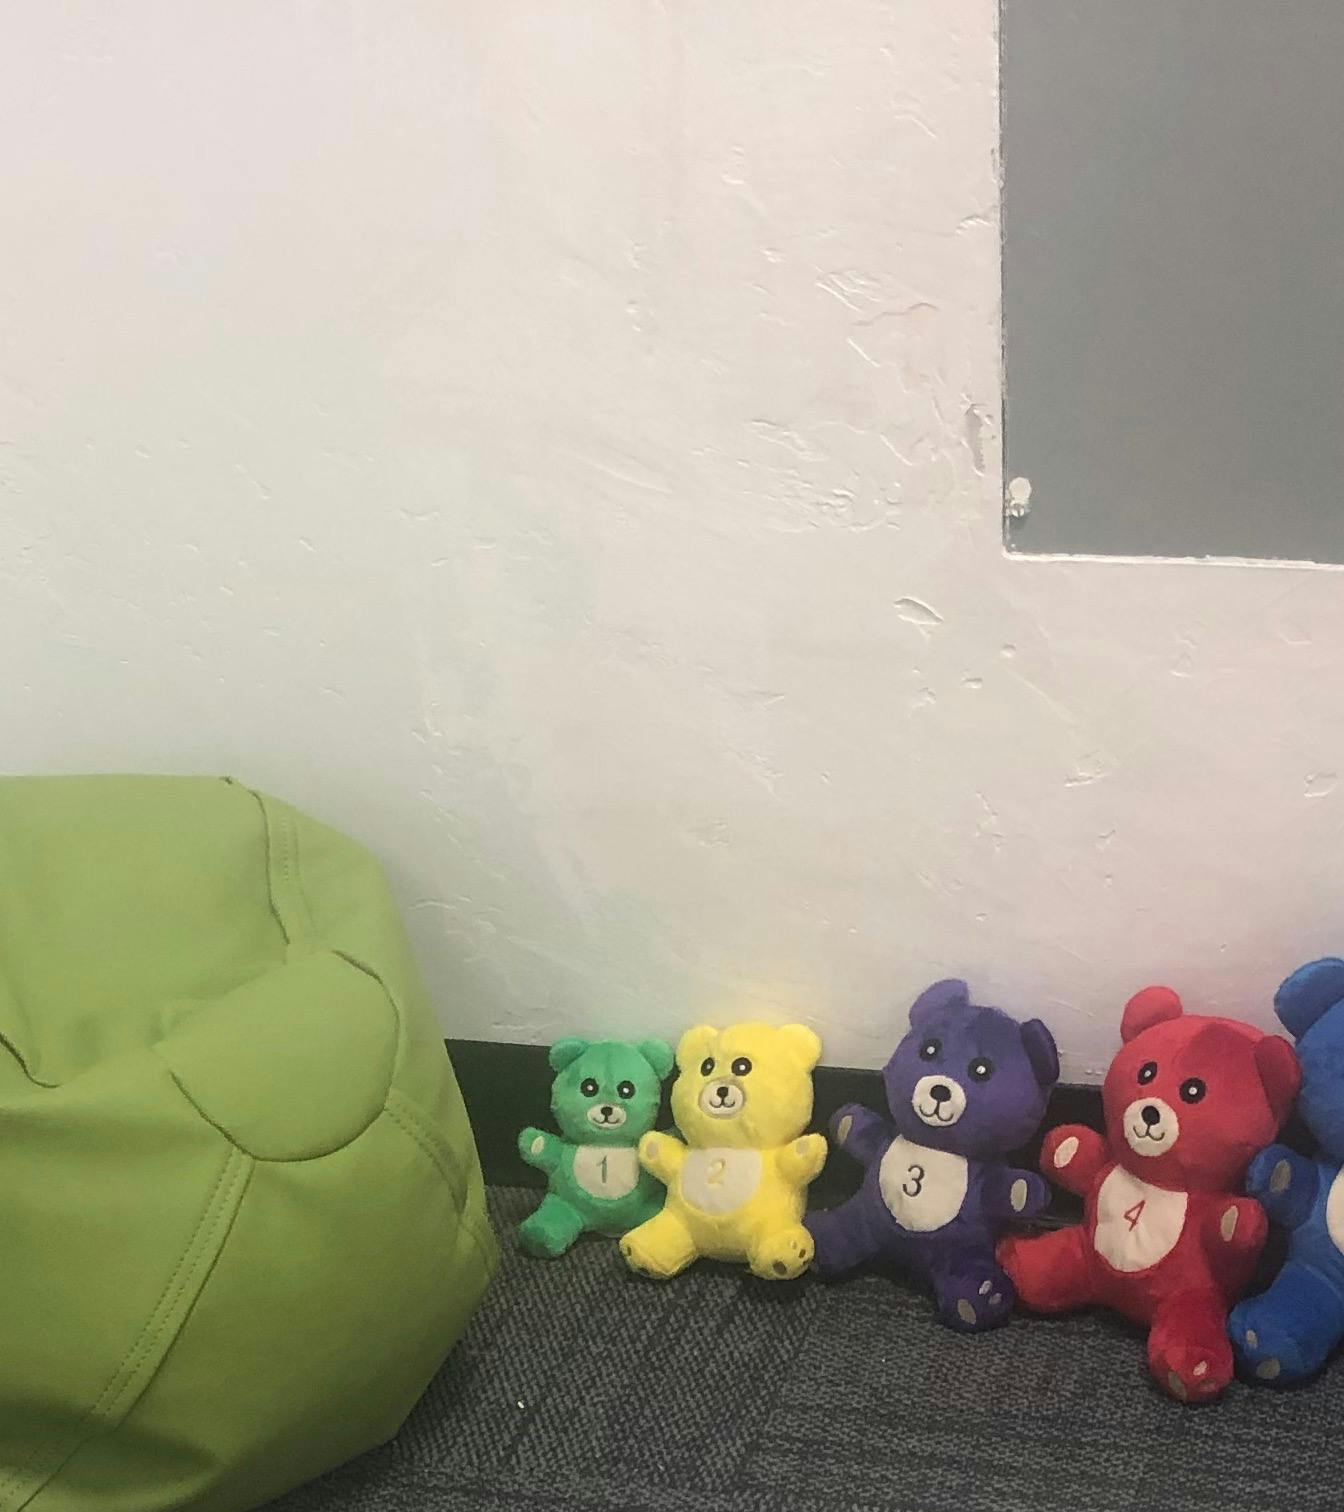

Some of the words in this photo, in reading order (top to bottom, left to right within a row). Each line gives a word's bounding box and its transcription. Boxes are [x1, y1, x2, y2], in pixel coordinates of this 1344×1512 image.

[596, 1155, 608, 1184] 1
[707, 1157, 727, 1187] 2
[902, 1165, 926, 1197] 3
[1124, 1199, 1146, 1232] 4
